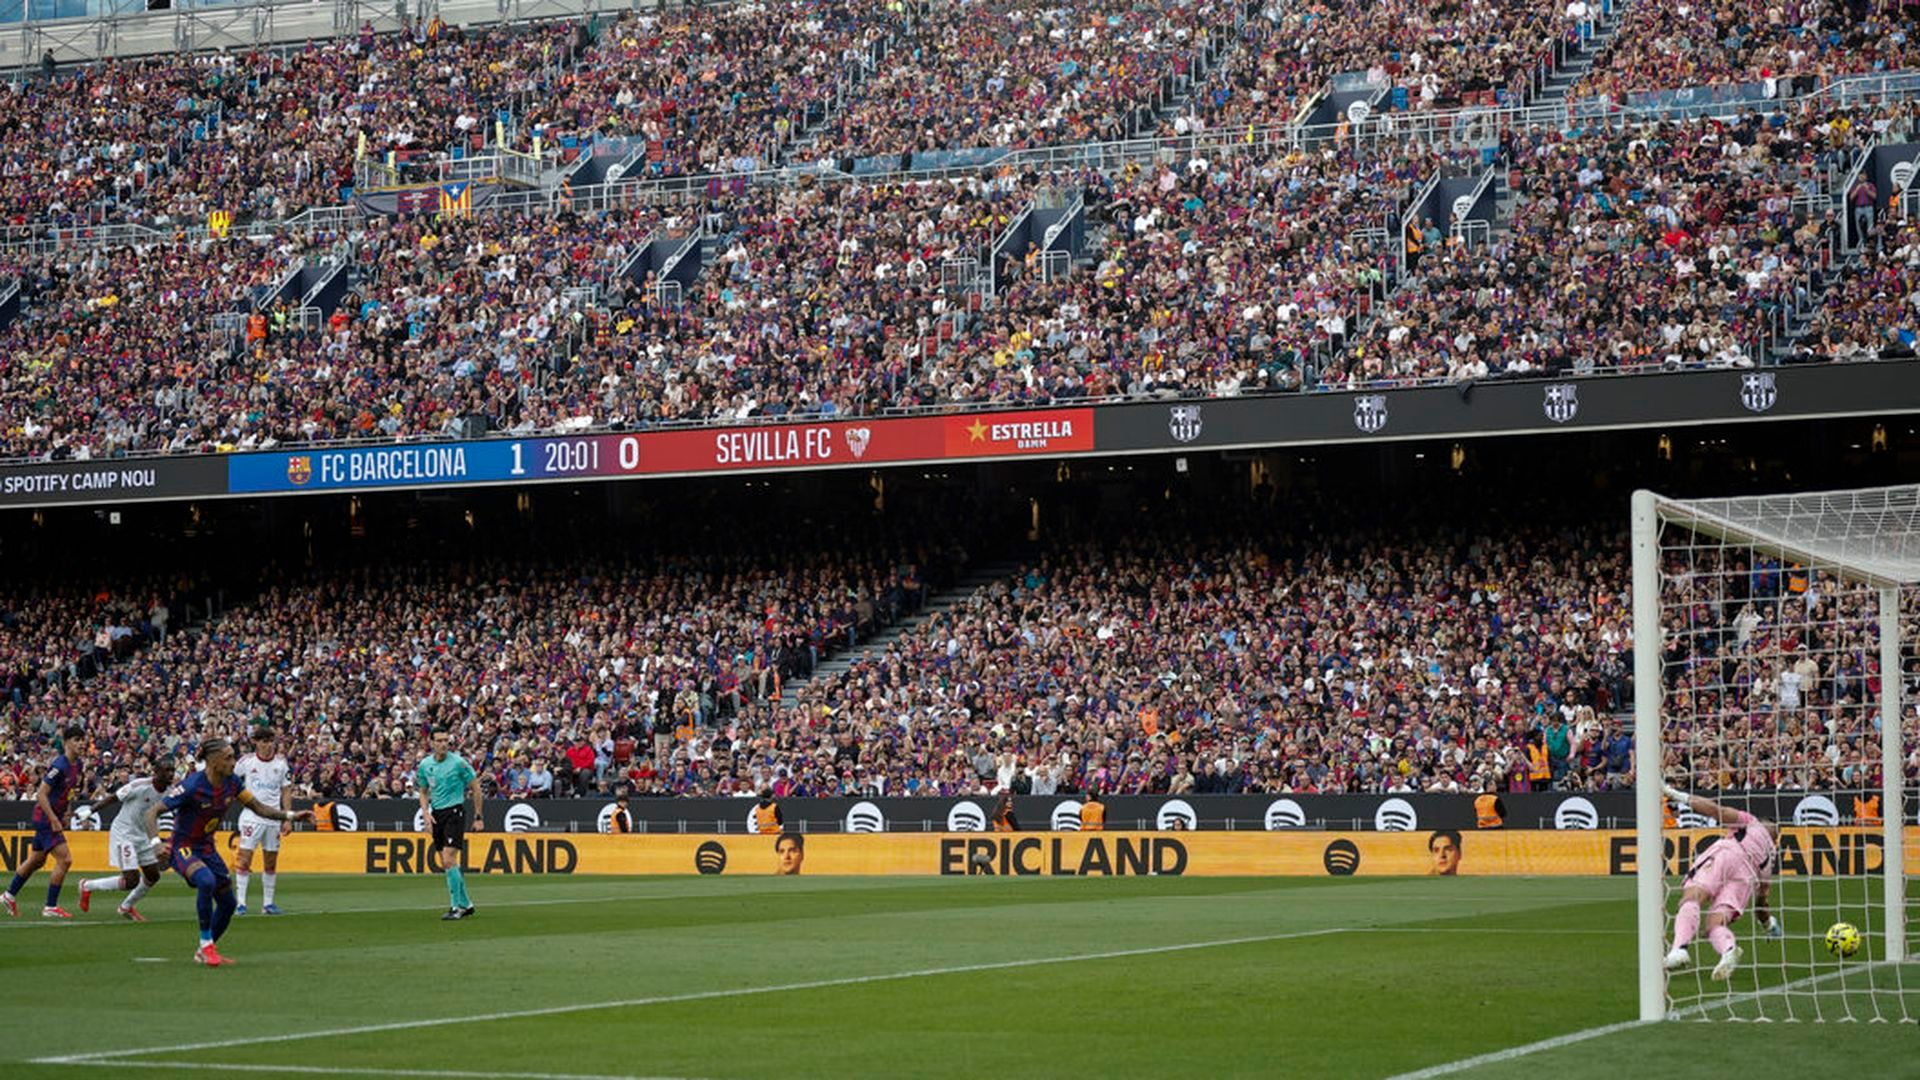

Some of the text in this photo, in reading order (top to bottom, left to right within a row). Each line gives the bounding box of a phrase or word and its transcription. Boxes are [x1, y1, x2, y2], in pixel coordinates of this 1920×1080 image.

[991, 421, 1073, 440] ESTRELLA
[1017, 439, 1047, 449] DAMM
[321, 428, 831, 483] FC BARCELONA 1 20:01 0 SEVILLA FC
[4, 469, 156, 493] SPOTIFY CAMP NOU
[462, 839, 578, 874] LAND
[940, 838, 1188, 875] ERIC LAND
